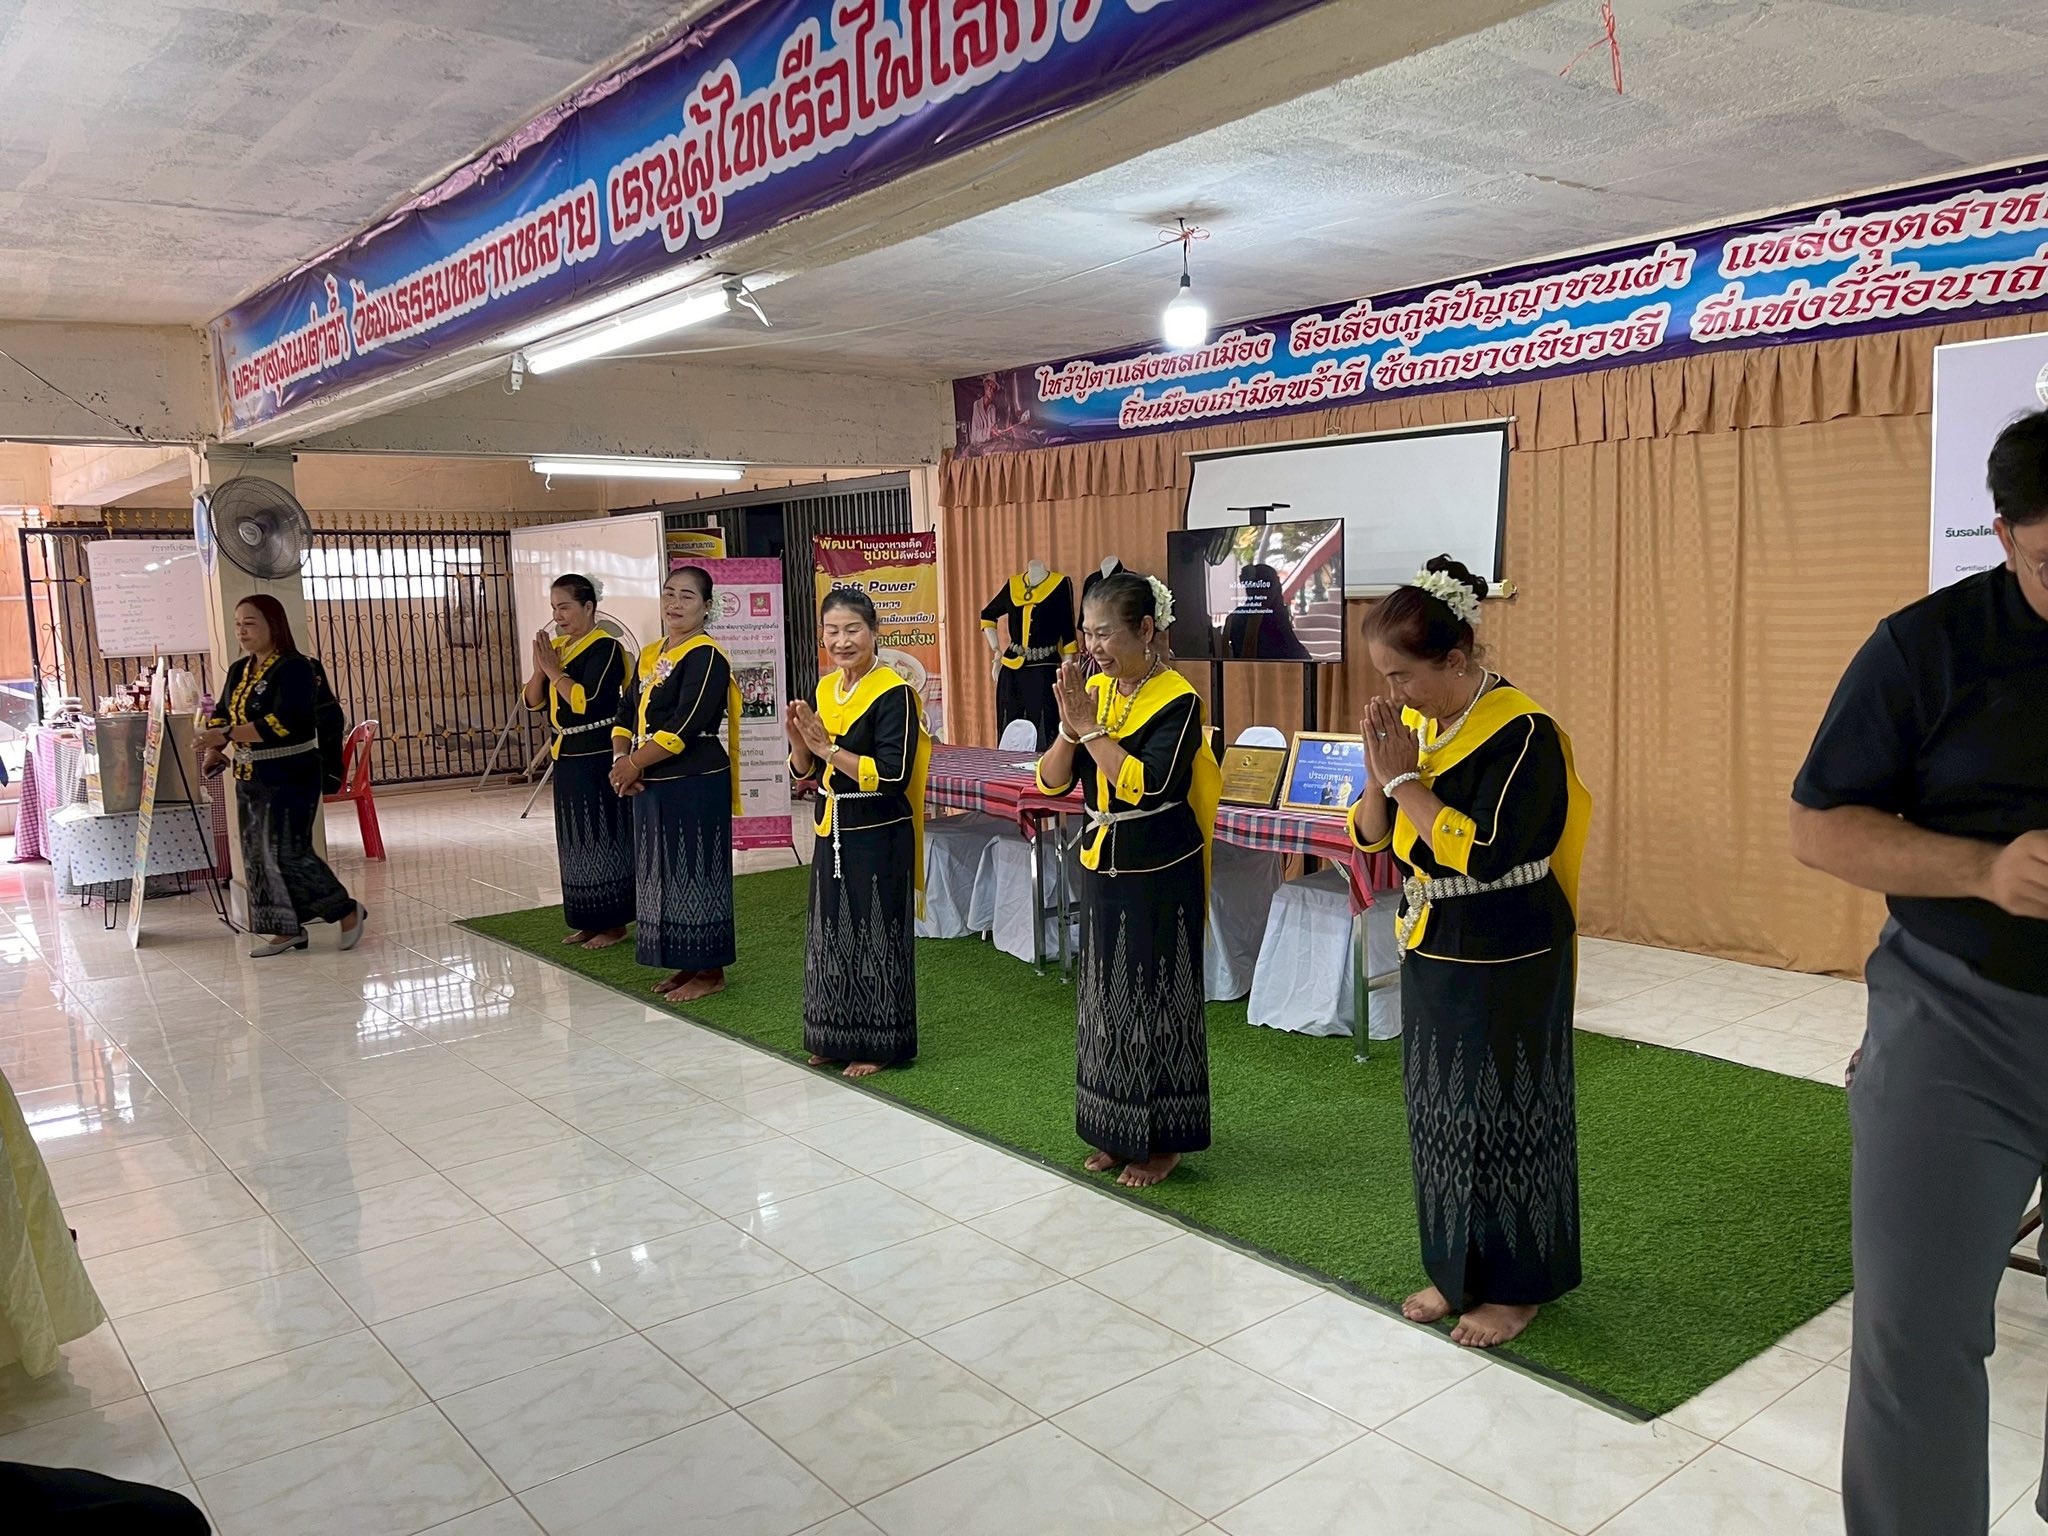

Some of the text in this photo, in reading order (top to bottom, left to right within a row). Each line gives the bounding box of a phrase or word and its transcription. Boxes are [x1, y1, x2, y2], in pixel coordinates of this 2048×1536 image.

[353, 191, 596, 346] วัฒนธรรมหลากหลาย
[1293, 250, 1690, 352] ลือเลื่องภูมิปัญญาชนเผ่า
[1725, 190, 2048, 271] แหล่งอุตสาห
[869, 581, 915, 592] Power
